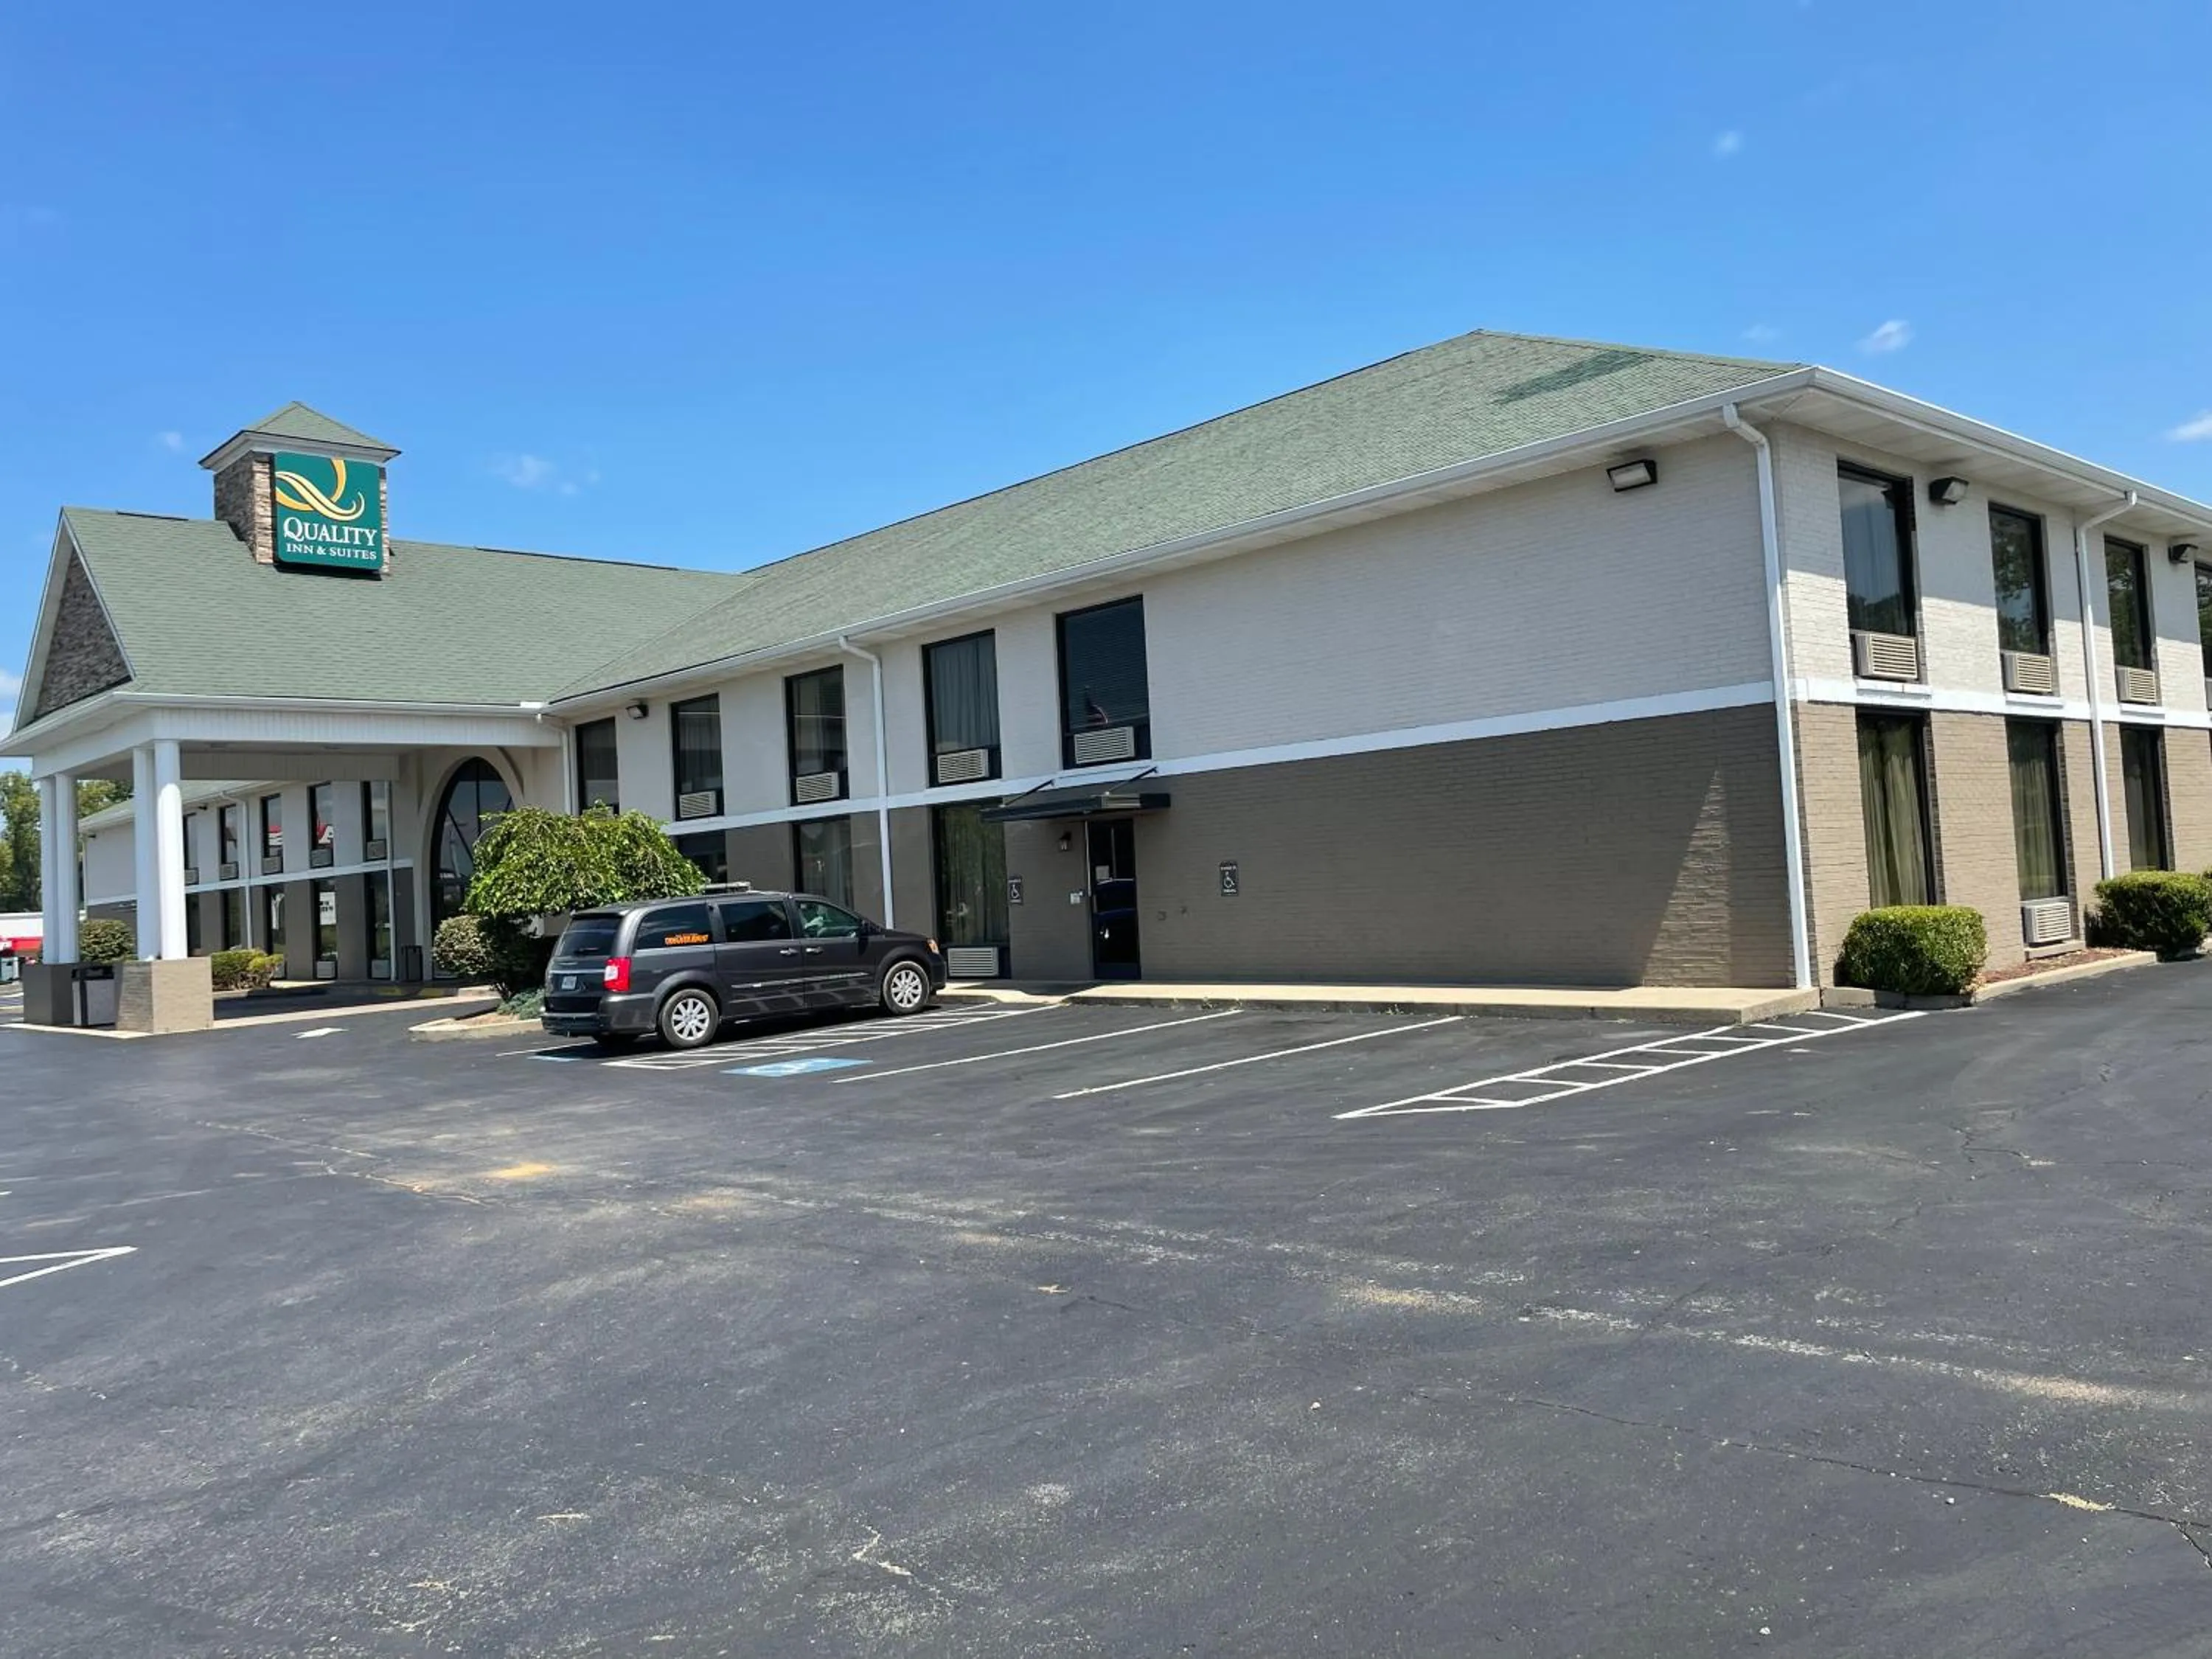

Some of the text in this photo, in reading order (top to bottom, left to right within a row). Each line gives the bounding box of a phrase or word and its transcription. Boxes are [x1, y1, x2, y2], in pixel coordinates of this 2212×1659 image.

[283, 517, 378, 546] QUALITY
[286, 543, 377, 560] INN & SUITES
